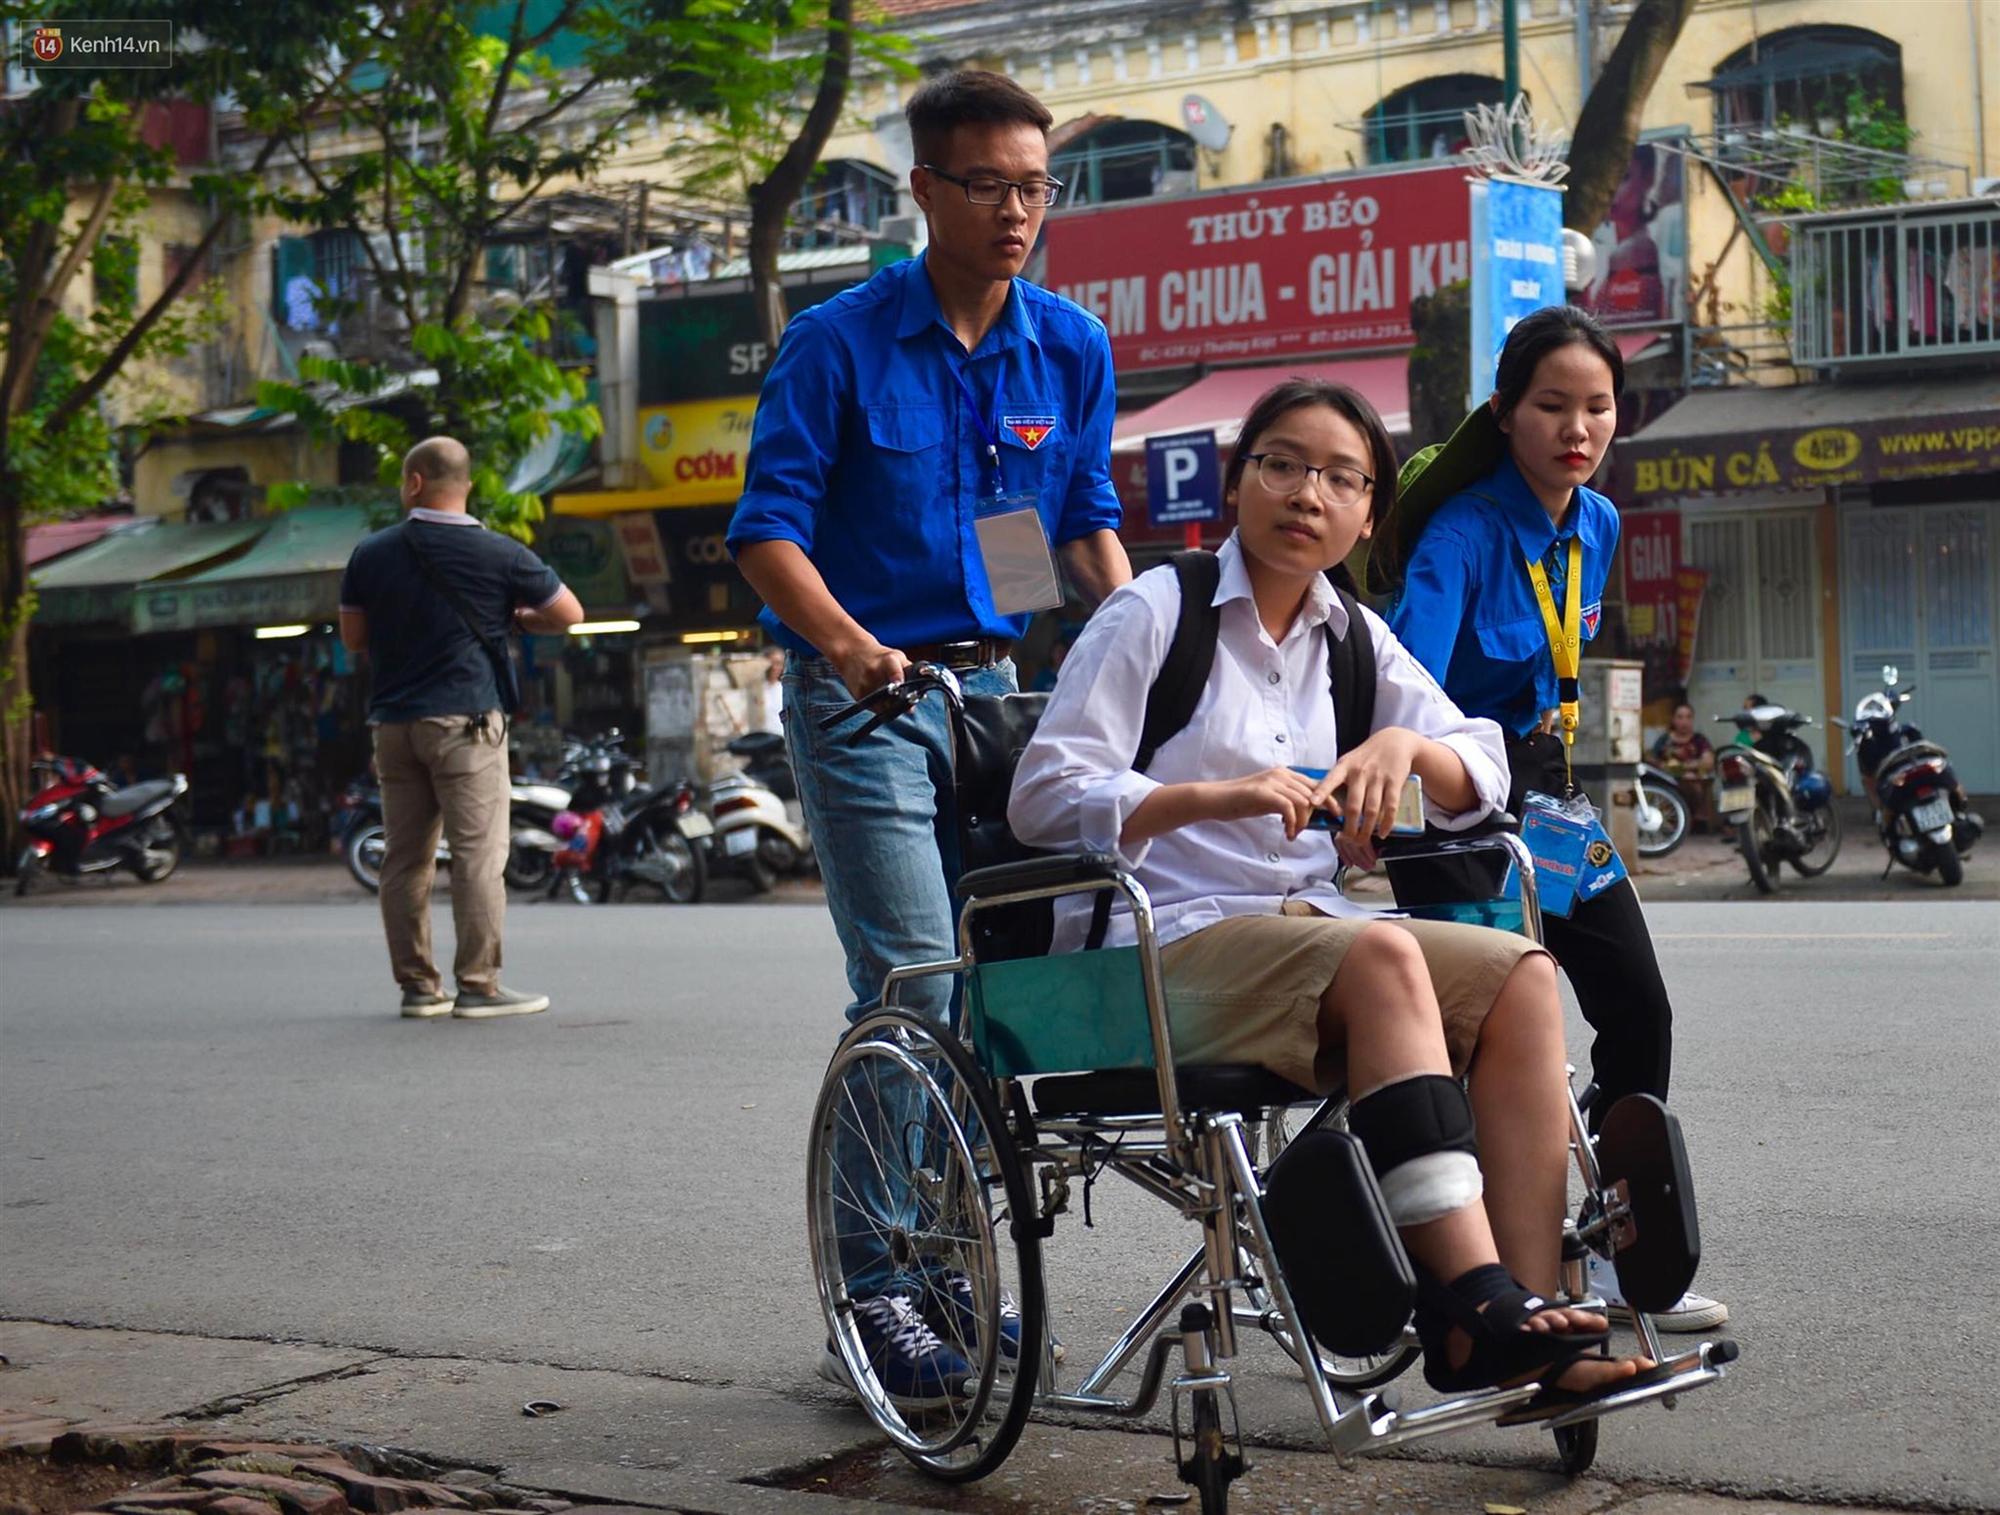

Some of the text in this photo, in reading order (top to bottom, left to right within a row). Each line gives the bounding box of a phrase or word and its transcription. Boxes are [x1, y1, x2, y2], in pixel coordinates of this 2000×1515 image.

[1187, 191, 1380, 246] THỦY BÉO
[1057, 275, 1146, 338] EM
[1159, 262, 1267, 332] CHUA
[1278, 285, 1296, 300] -
[1308, 229, 1396, 317] GIẢI
[674, 449, 738, 483] CƠM
[1165, 447, 1199, 501] P
[1633, 440, 1782, 493] BÚN CÁ
[1630, 518, 1673, 582] GIẢI
